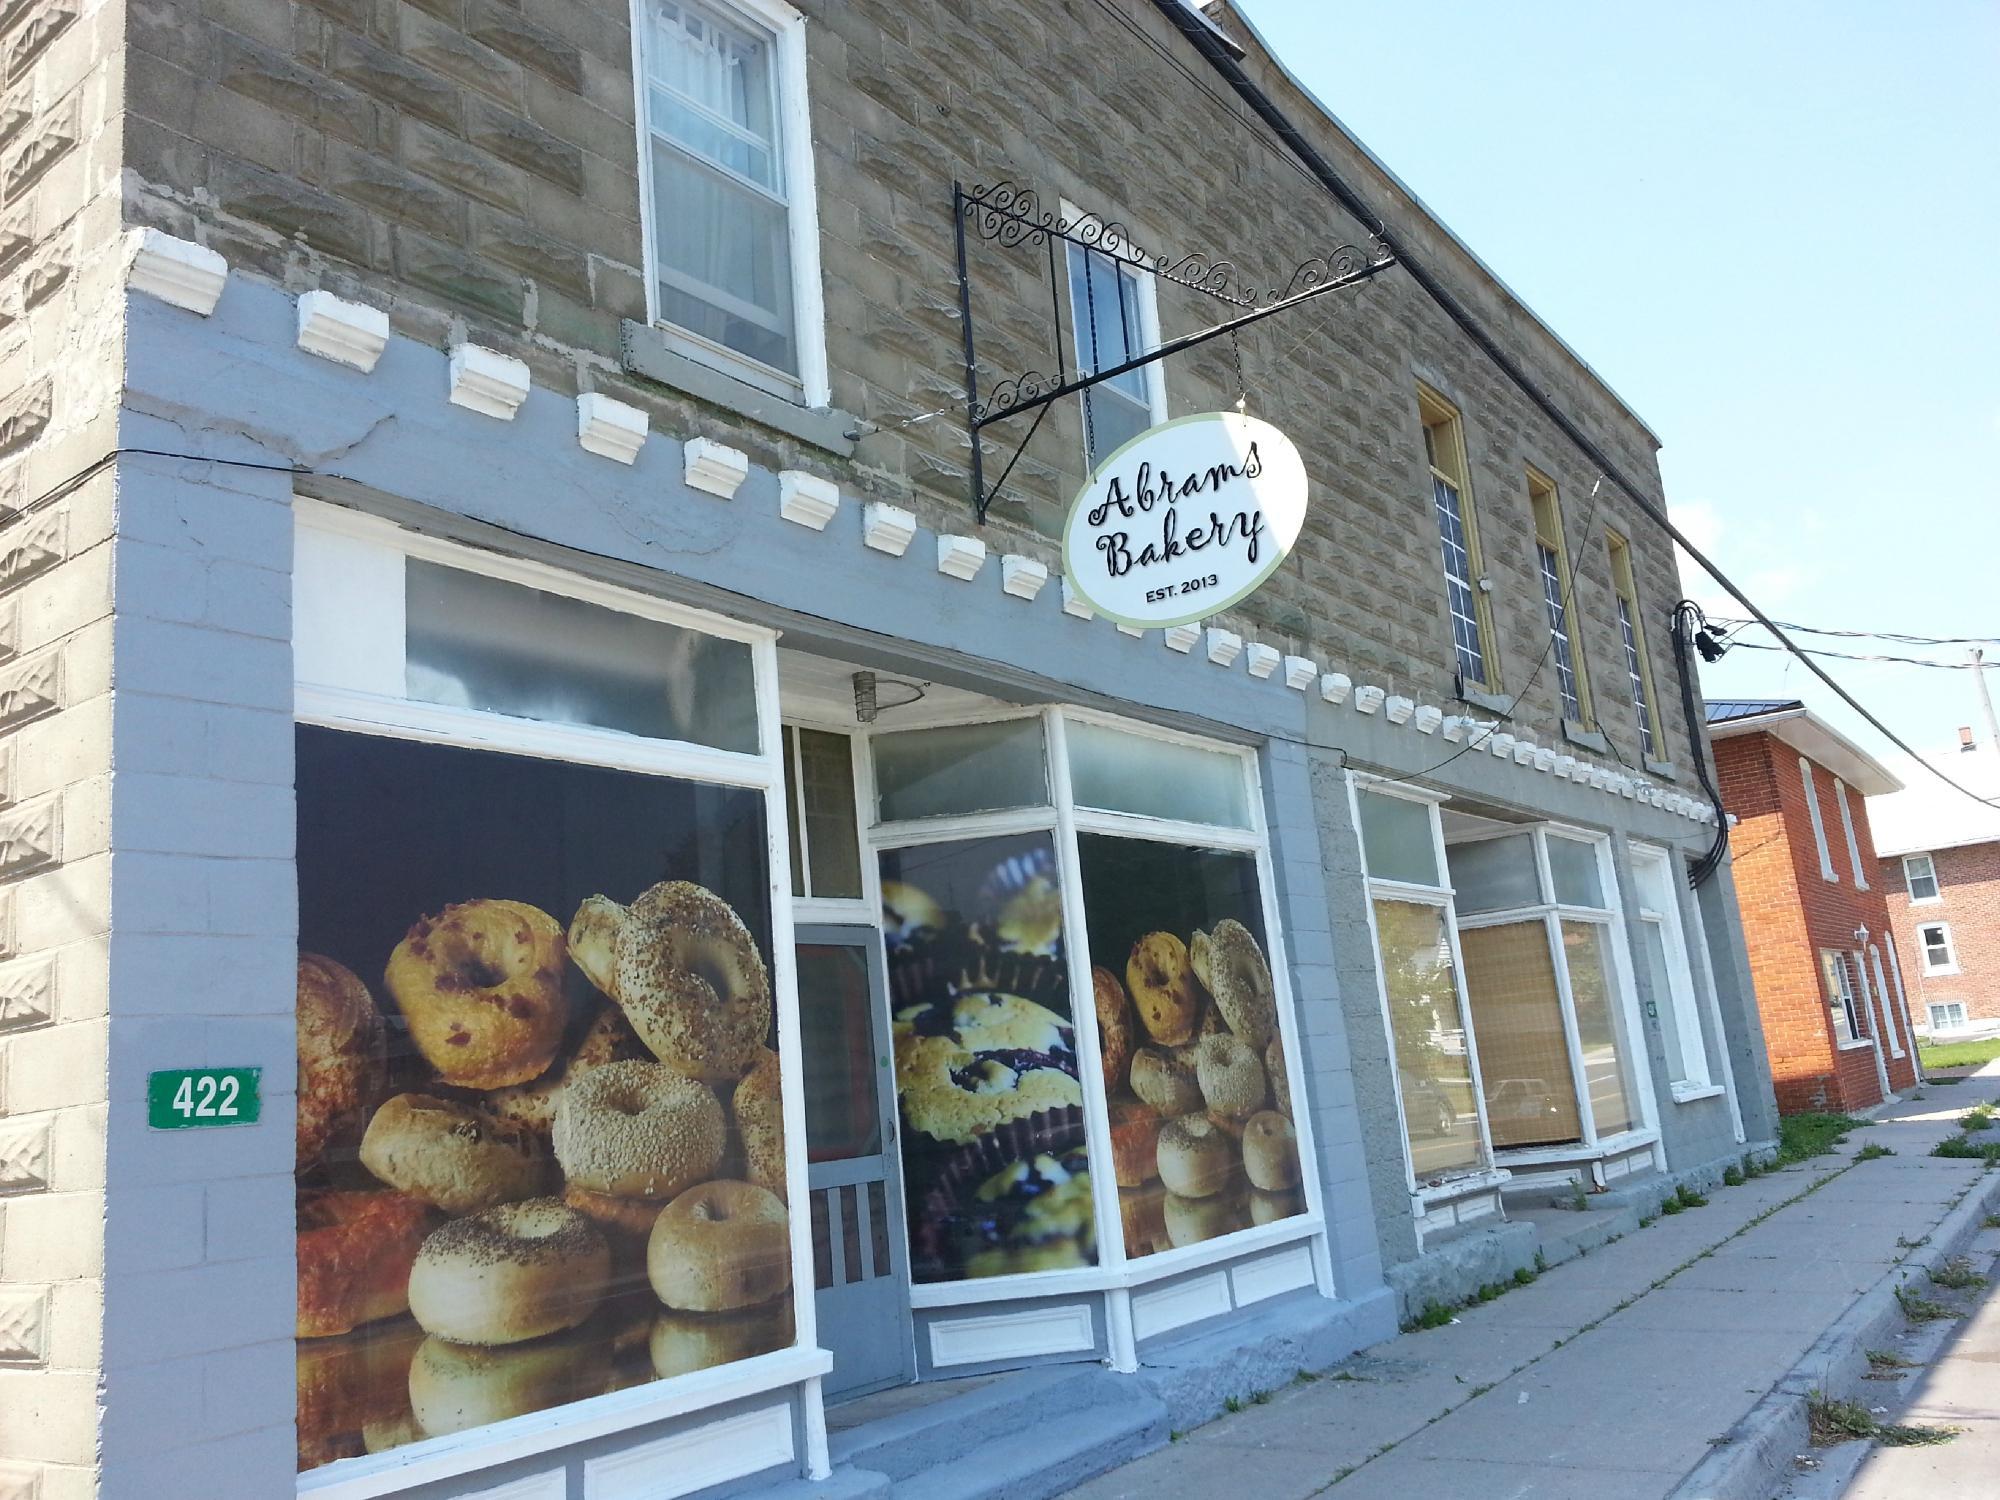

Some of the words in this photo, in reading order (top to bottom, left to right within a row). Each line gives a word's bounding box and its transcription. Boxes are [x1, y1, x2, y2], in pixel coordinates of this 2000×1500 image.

[1088, 441, 1262, 526] Abrams
[1096, 507, 1265, 577] Bakery
[1146, 585, 1178, 603] EST.
[1181, 574, 1218, 595] 2013
[173, 1075, 240, 1118] 422
